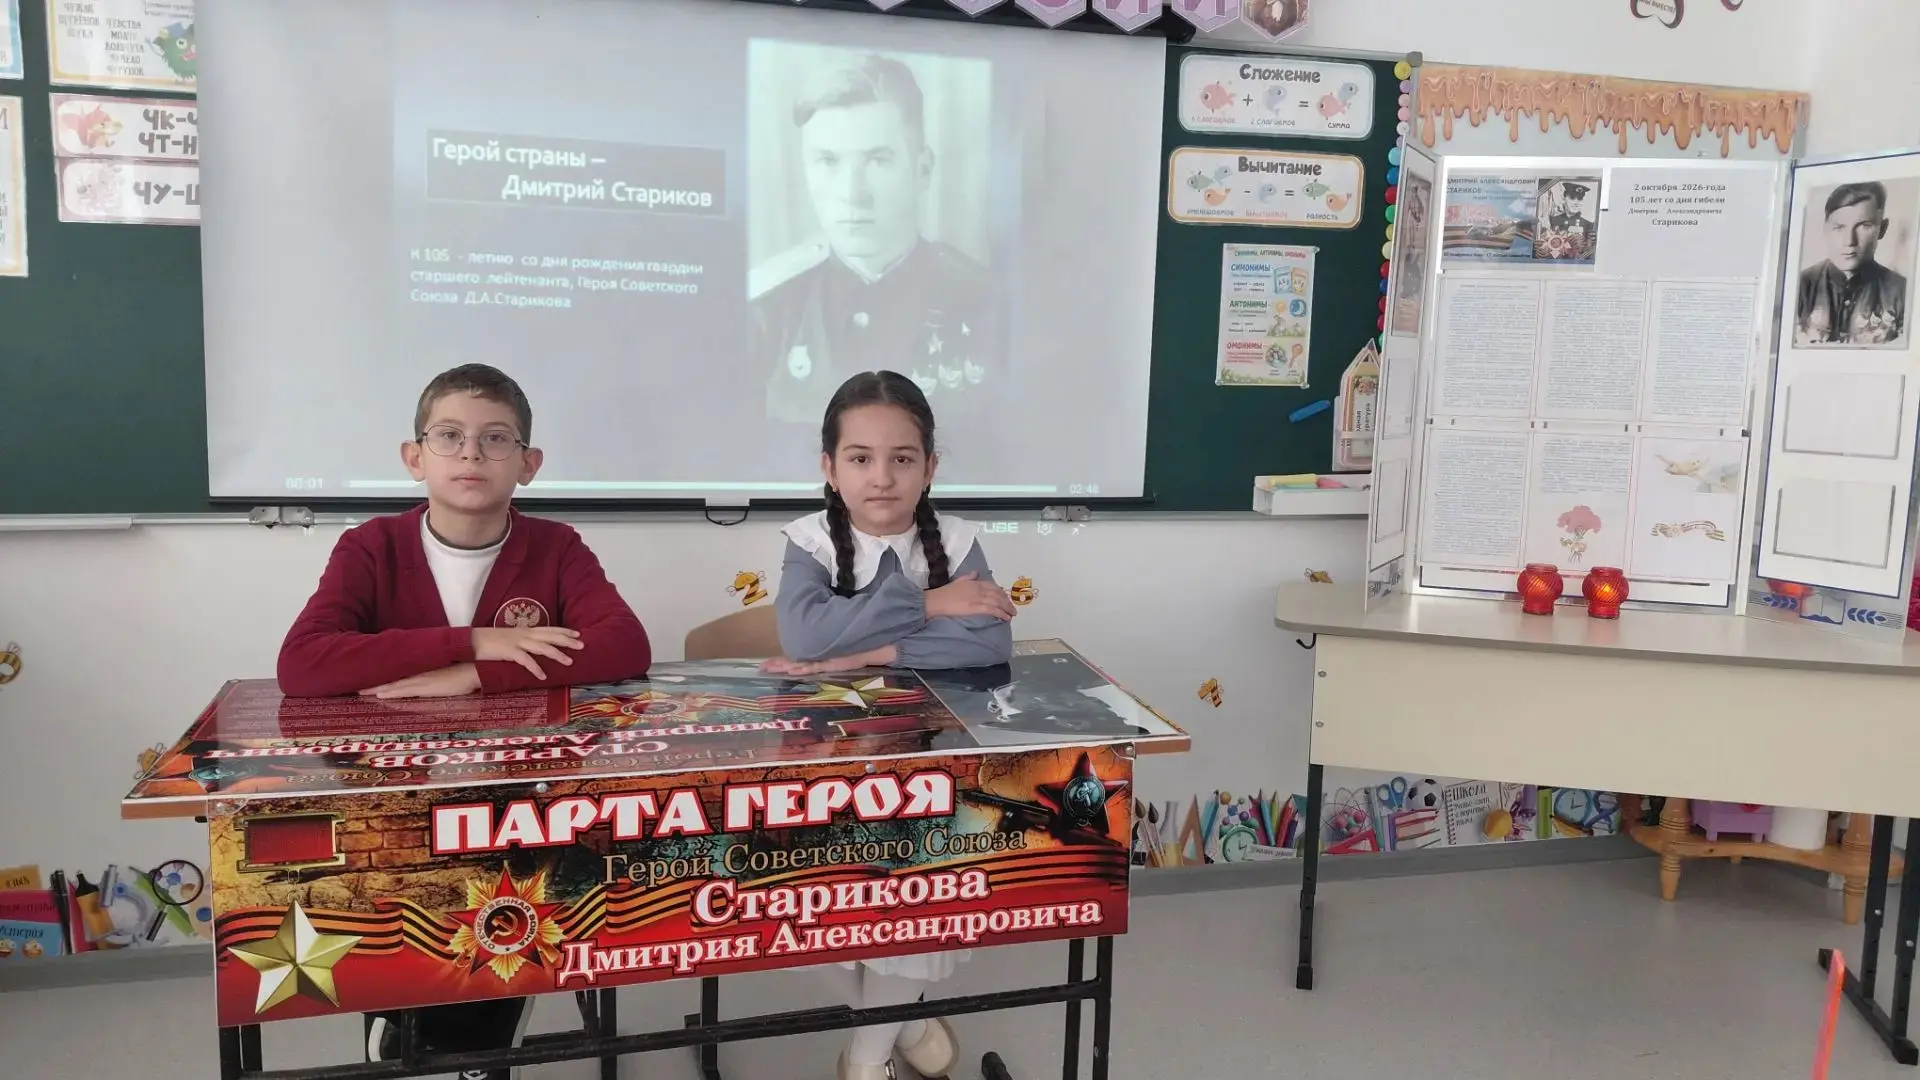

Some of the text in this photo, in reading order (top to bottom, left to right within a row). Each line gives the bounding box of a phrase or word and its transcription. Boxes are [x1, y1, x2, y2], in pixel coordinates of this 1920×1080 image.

[1239, 63, 1321, 84] Сложение
[433, 138, 500, 166] Герой
[505, 147, 586, 170] страны
[1238, 156, 1322, 176] Вычитание
[501, 174, 713, 208] Дмитрий Стариков
[1634, 183, 1640, 191] 2
[1641, 183, 1678, 192] октября
[1630, 196, 1646, 204] 105
[1676, 197, 1692, 205] дня
[1694, 196, 1726, 204] гибели
[1652, 218, 1698, 227] Старикова
[468, 252, 514, 265] летию
[521, 255, 538, 266] со
[541, 256, 568, 268] дня
[571, 257, 645, 272] рождения
[646, 260, 704, 276] гвардии
[1231, 263, 1271, 272] СИНОНИМЫ
[410, 269, 480, 284] старшего
[577, 275, 618, 292] Героя
[620, 278, 699, 295] Советского
[410, 288, 459, 304] Союза
[1229, 300, 1268, 308] АНТОНИМЫ
[205, 715, 813, 758] Дмитрий Александрович
[370, 740, 669, 769] СТАРИКОВ
[433, 772, 953, 853] ПАРТА ГЕРОЯ
[602, 828, 1027, 887] Герой Советского Союза
[694, 869, 991, 926] Старикова
[557, 900, 1103, 986] Дмитрия Александровича
